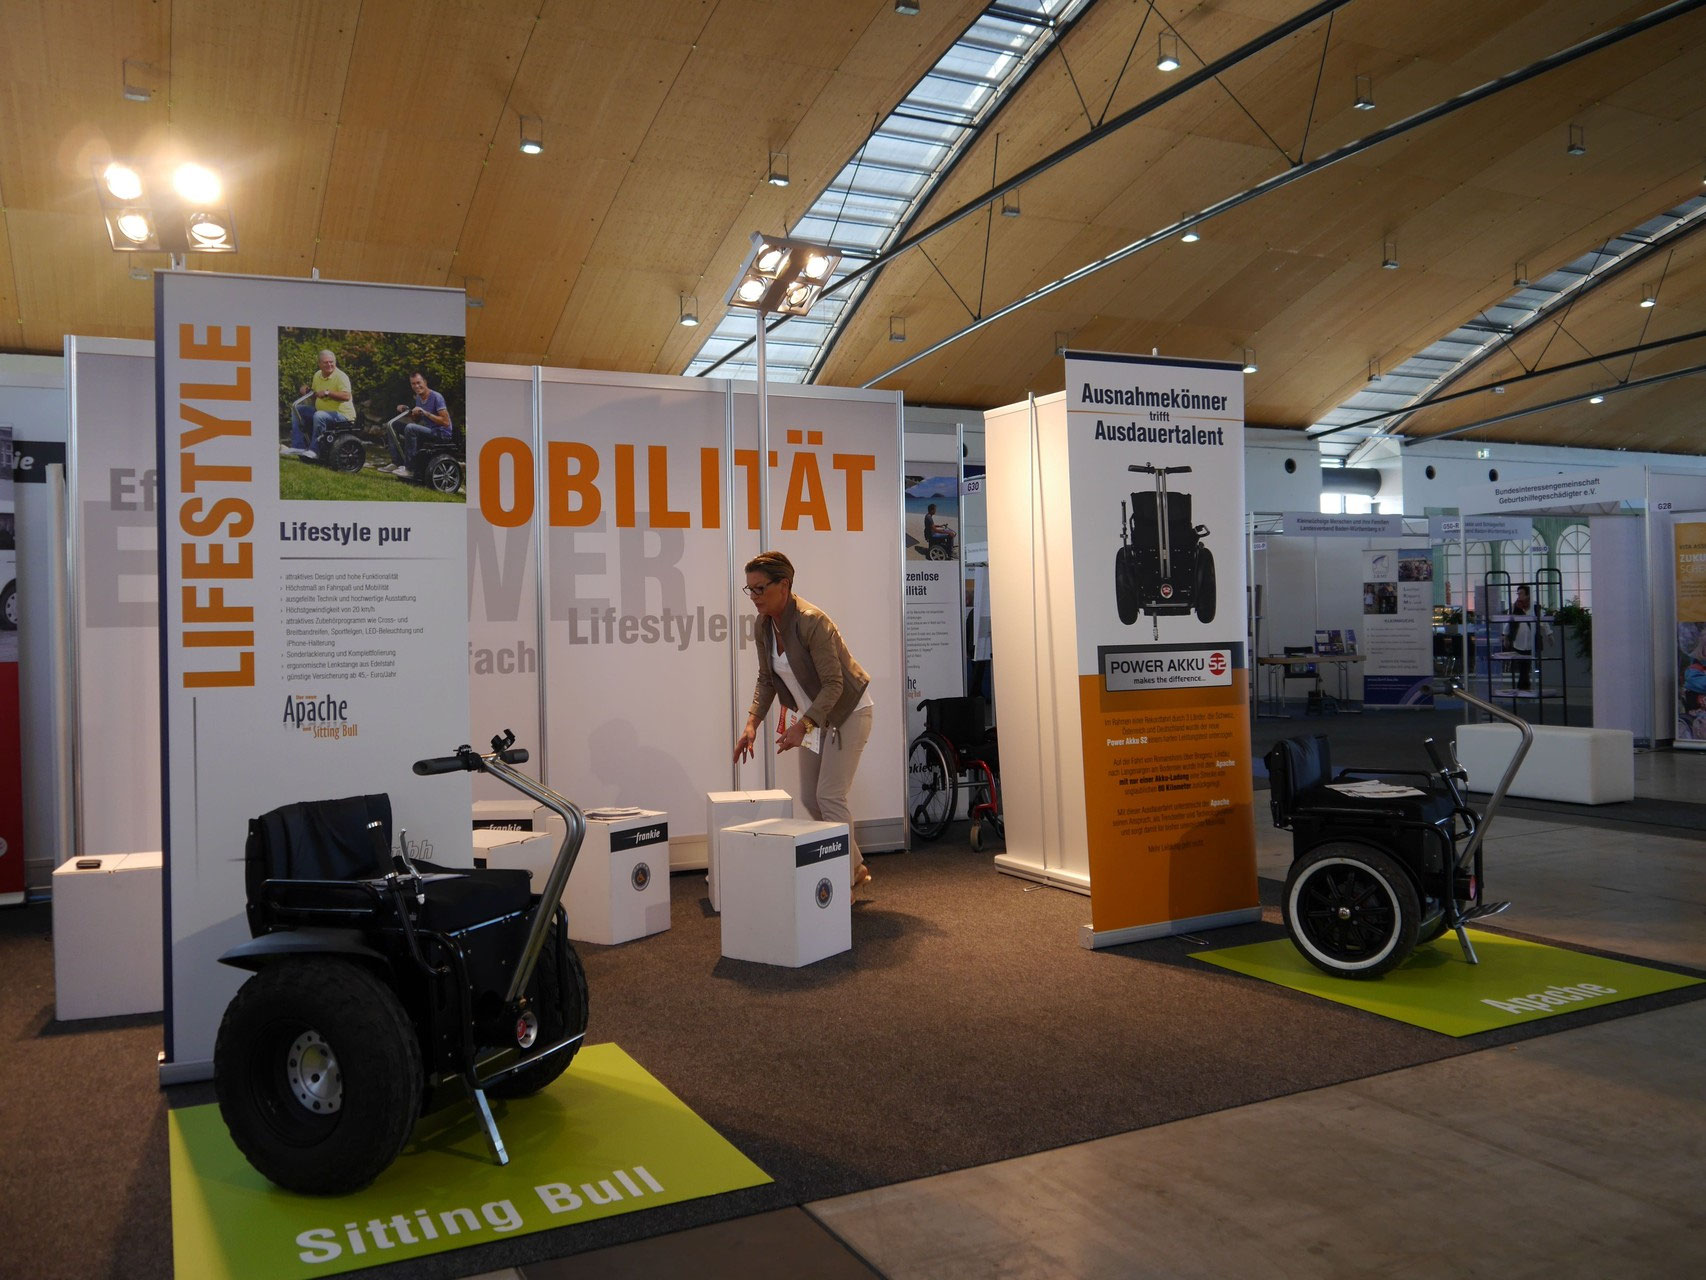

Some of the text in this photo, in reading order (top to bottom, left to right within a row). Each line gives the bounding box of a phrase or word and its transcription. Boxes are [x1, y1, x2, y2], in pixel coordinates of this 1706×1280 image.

[1081, 383, 1228, 411] Ausnahmekönner
[1149, 411, 1170, 422] trifft
[1095, 420, 1224, 446] Ausdauertalent
[967, 481, 979, 492] G30
[1495, 478, 1600, 496] Bundesinteressengemeinschaft
[179, 323, 255, 688] LIFESTYLE
[1498, 490, 1582, 505] Geburtshilfegeschädigter
[280, 521, 412, 547] Lifestyle pur
[568, 606, 728, 651] Lifestyle
[287, 662, 326, 670] ergonomische
[1110, 660, 1164, 674] POWER
[1168, 658, 1205, 672] AKKU
[312, 673, 348, 681] Versicherung
[1134, 676, 1156, 684] makes
[283, 694, 348, 728] Apache
[313, 725, 339, 740] Sitting
[342, 724, 358, 737] Bull
[636, 829, 661, 844] frankie
[819, 841, 842, 858] frankie
[1480, 982, 1618, 1015] Apache
[295, 1166, 666, 1264] Sitting Bull
